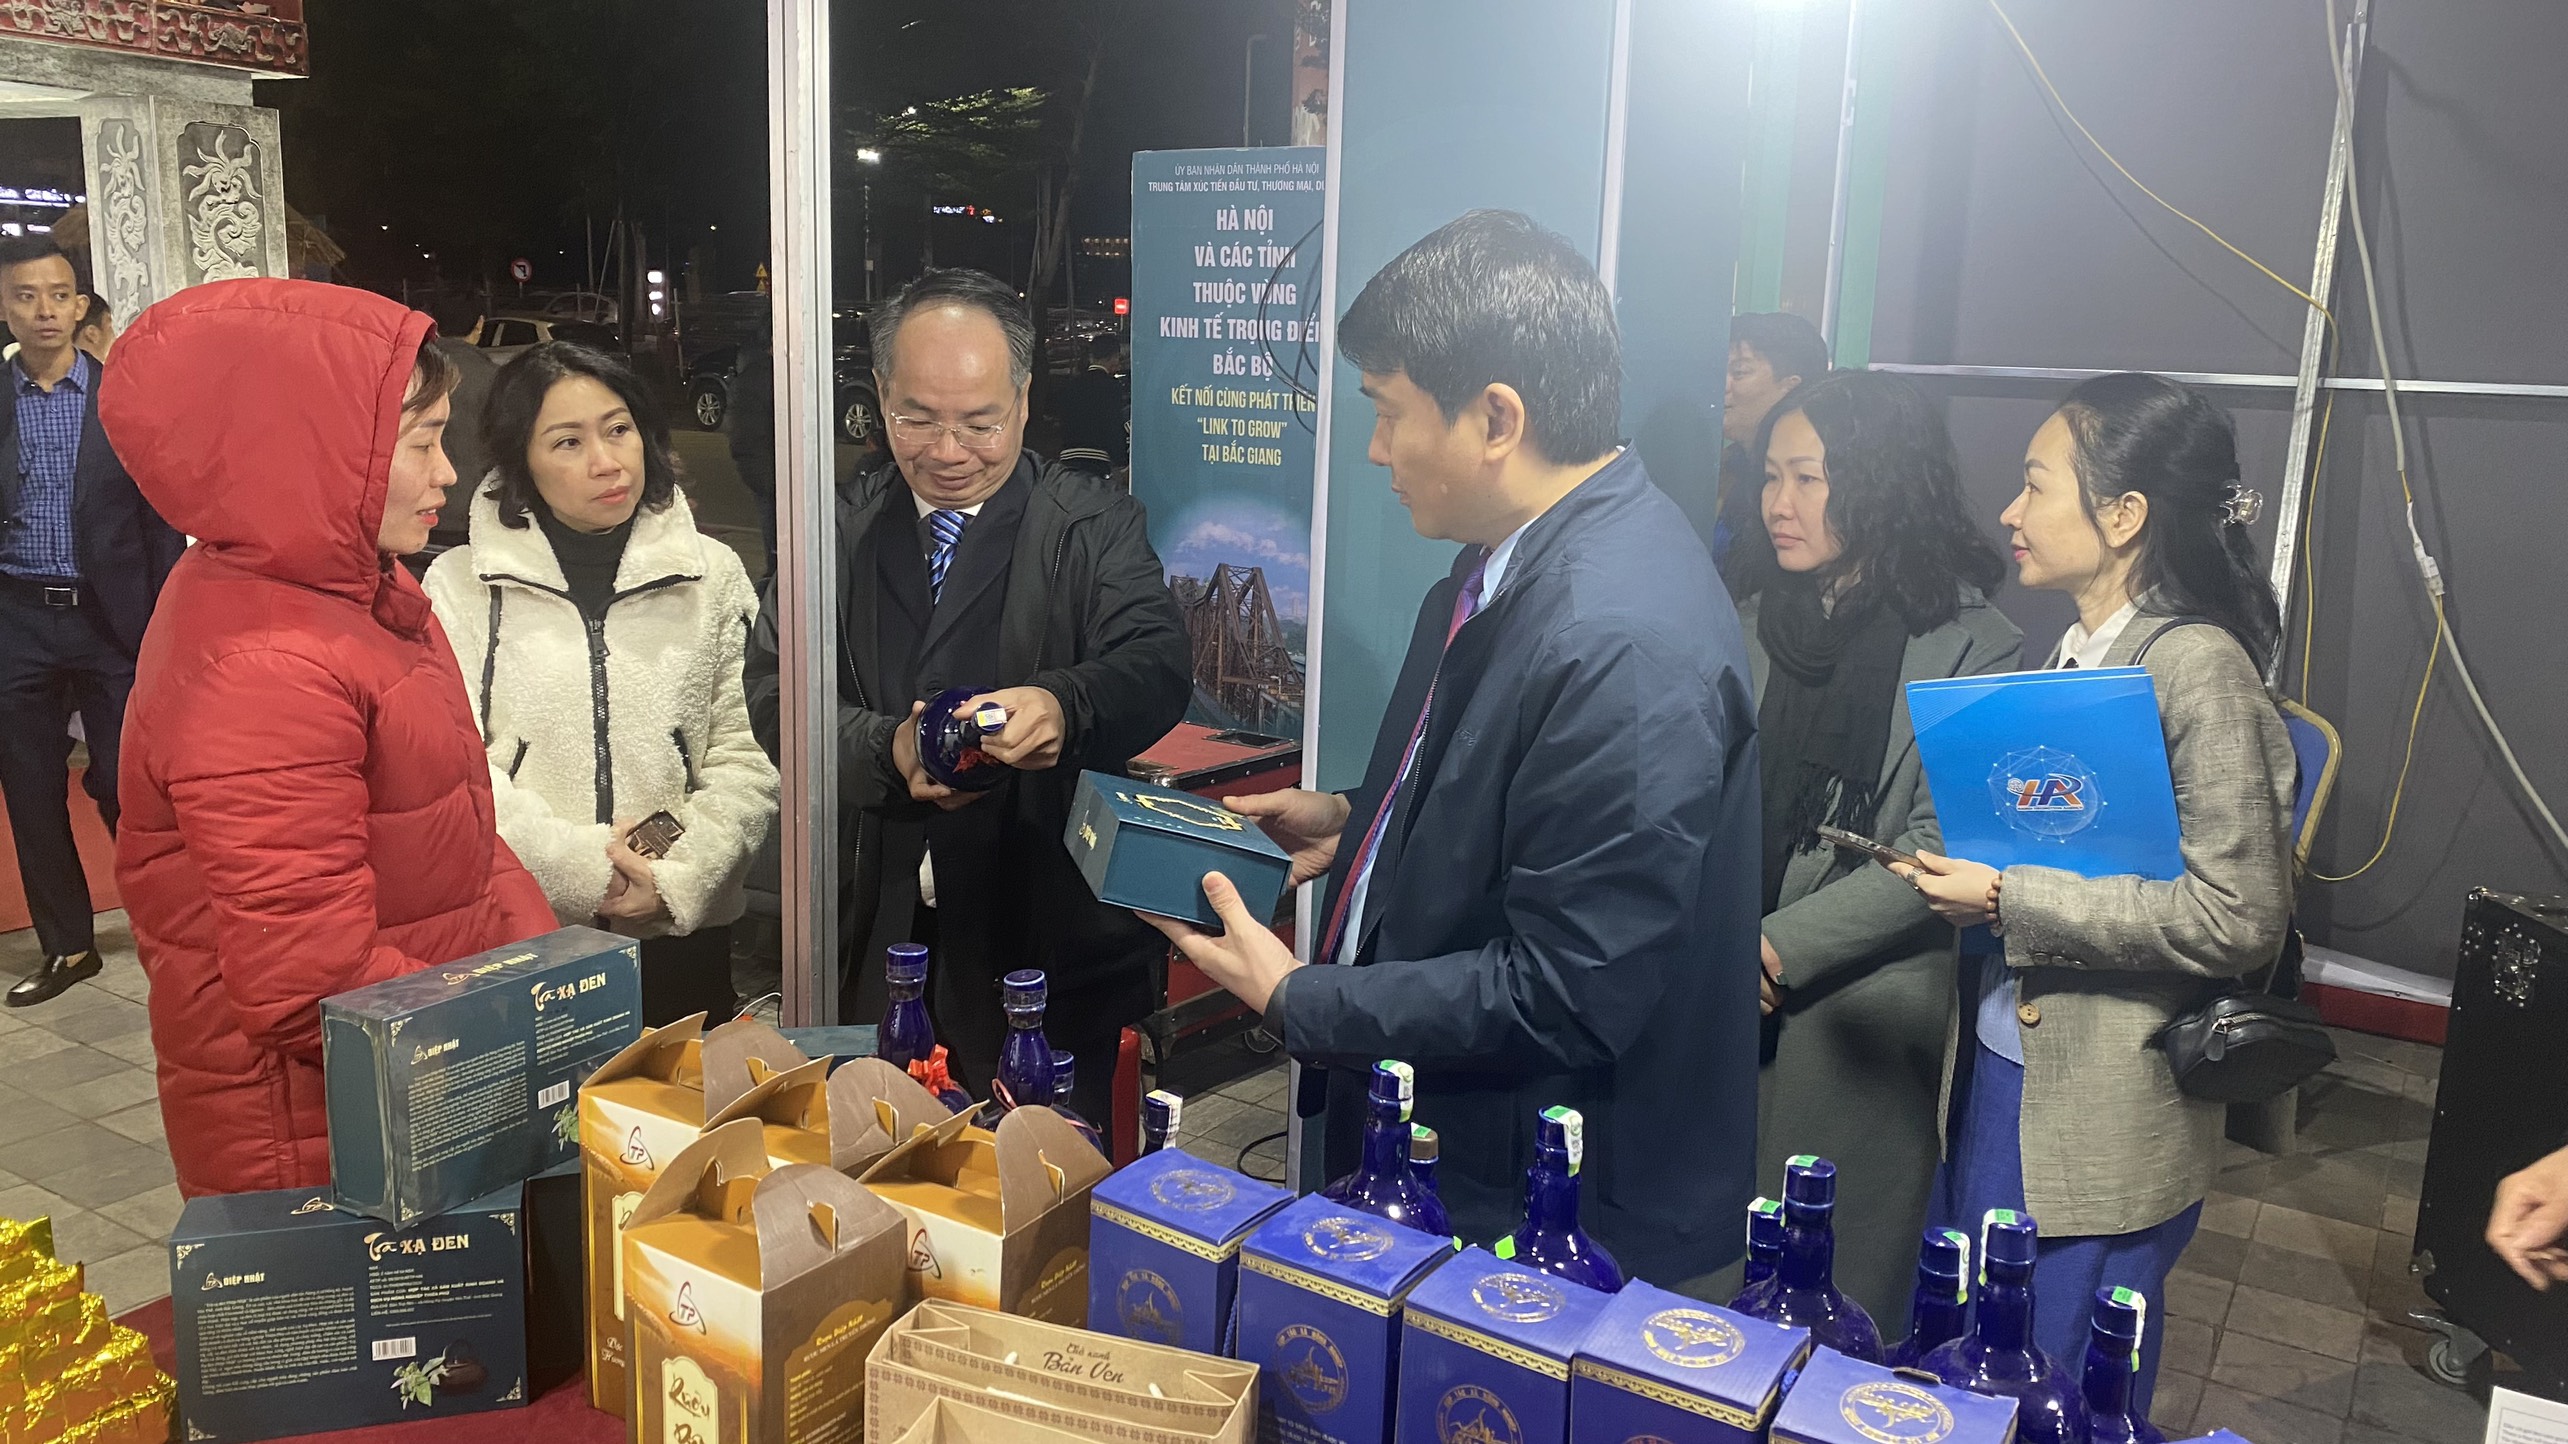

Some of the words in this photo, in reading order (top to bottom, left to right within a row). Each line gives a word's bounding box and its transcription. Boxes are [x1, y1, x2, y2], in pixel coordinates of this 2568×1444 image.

[1187, 165, 1202, 175] BAN
[1204, 163, 1225, 175] NHÂN
[1227, 163, 1243, 174] DÂN
[1245, 162, 1271, 174] THÀNH
[1274, 161, 1290, 174] PHỐ
[1292, 162, 1303, 174] HÀ
[1305, 162, 1320, 175] NỘI
[1148, 181, 1173, 192] TRUNG
[1175, 180, 1191, 192] TÂM
[1193, 179, 1208, 191] XÚC
[1210, 178, 1227, 191] TIẾN
[1229, 178, 1245, 191] ĐẦU
[1262, 180, 1294, 191] THƯƠNG
[1216, 204, 1239, 231] HÀ
[1244, 204, 1274, 235] NỘI
[1194, 241, 1216, 267] VÀ
[1220, 241, 1253, 267] CÁC
[1258, 239, 1296, 268] TỈNH
[1193, 278, 1246, 308] THUỘC
[1251, 279, 1296, 306] VÙNG
[1160, 316, 1198, 338] KINH
[1204, 312, 1224, 339] TẾ
[1227, 318, 1282, 344] TRỌNG
[1213, 347, 1246, 376] BẮC
[1251, 351, 1274, 381] BỘ
[1172, 383, 1192, 405] KẾT
[1195, 384, 1214, 407] NỐI
[1216, 387, 1246, 408] CÙNG
[1249, 389, 1279, 410] PHÁT
[1231, 419, 1245, 437] TO
[1202, 444, 1220, 464] TẠI
[1222, 440, 1245, 464] BẮC
[1247, 448, 1282, 466] GIANG
[556, 983, 576, 1000] XẠ
[579, 972, 607, 994] ĐEN
[400, 1236, 427, 1255] XẠ
[431, 1234, 470, 1252] ĐEN
[1043, 1351, 1083, 1376] Bản
[1089, 1361, 1124, 1384] Ven
